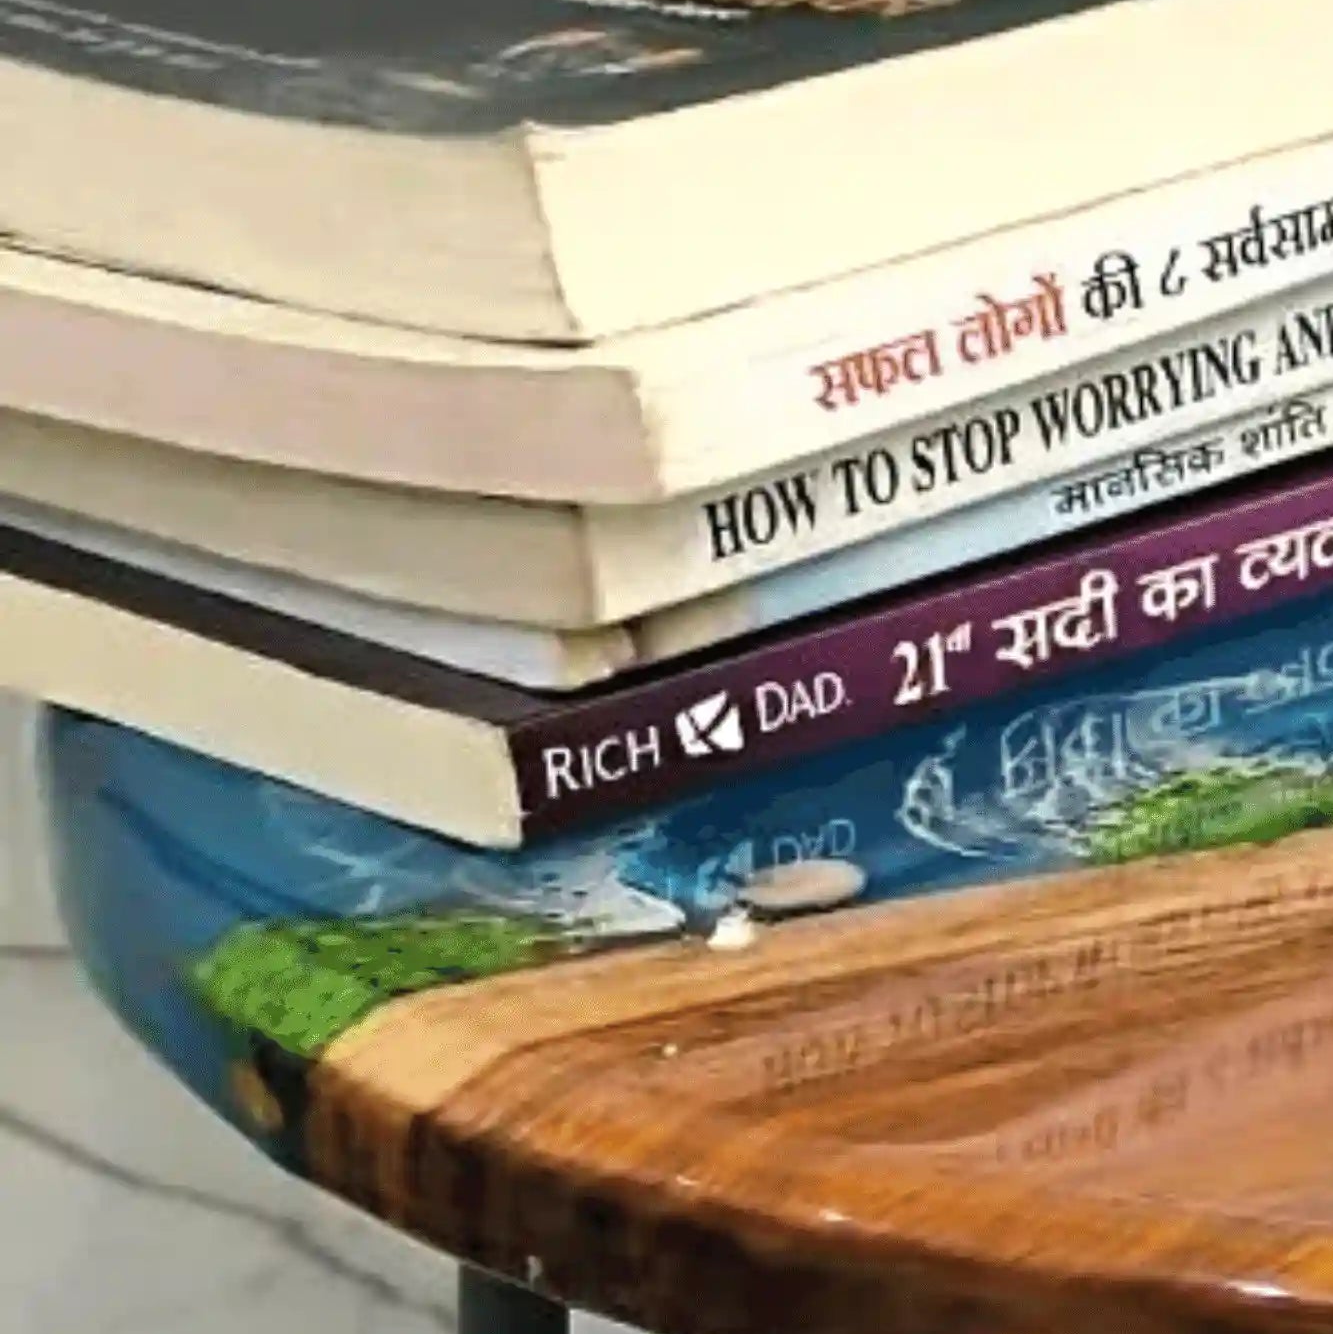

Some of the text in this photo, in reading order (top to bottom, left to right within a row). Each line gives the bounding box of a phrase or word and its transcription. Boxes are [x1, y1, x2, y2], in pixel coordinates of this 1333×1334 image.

[807, 329, 944, 411] सफल
[950, 271, 1067, 364] लोगों
[1080, 250, 1143, 319] की
[705, 472, 820, 563] HOW
[832, 450, 899, 515] TO
[911, 409, 1021, 494] STOP
[1031, 331, 1261, 452] WORRYING
[1050, 438, 1226, 518] मानसिक
[1240, 400, 1328, 460] शांति
[991, 568, 1119, 669] सदी
[1138, 554, 1218, 621] का
[542, 725, 661, 799] RICH
